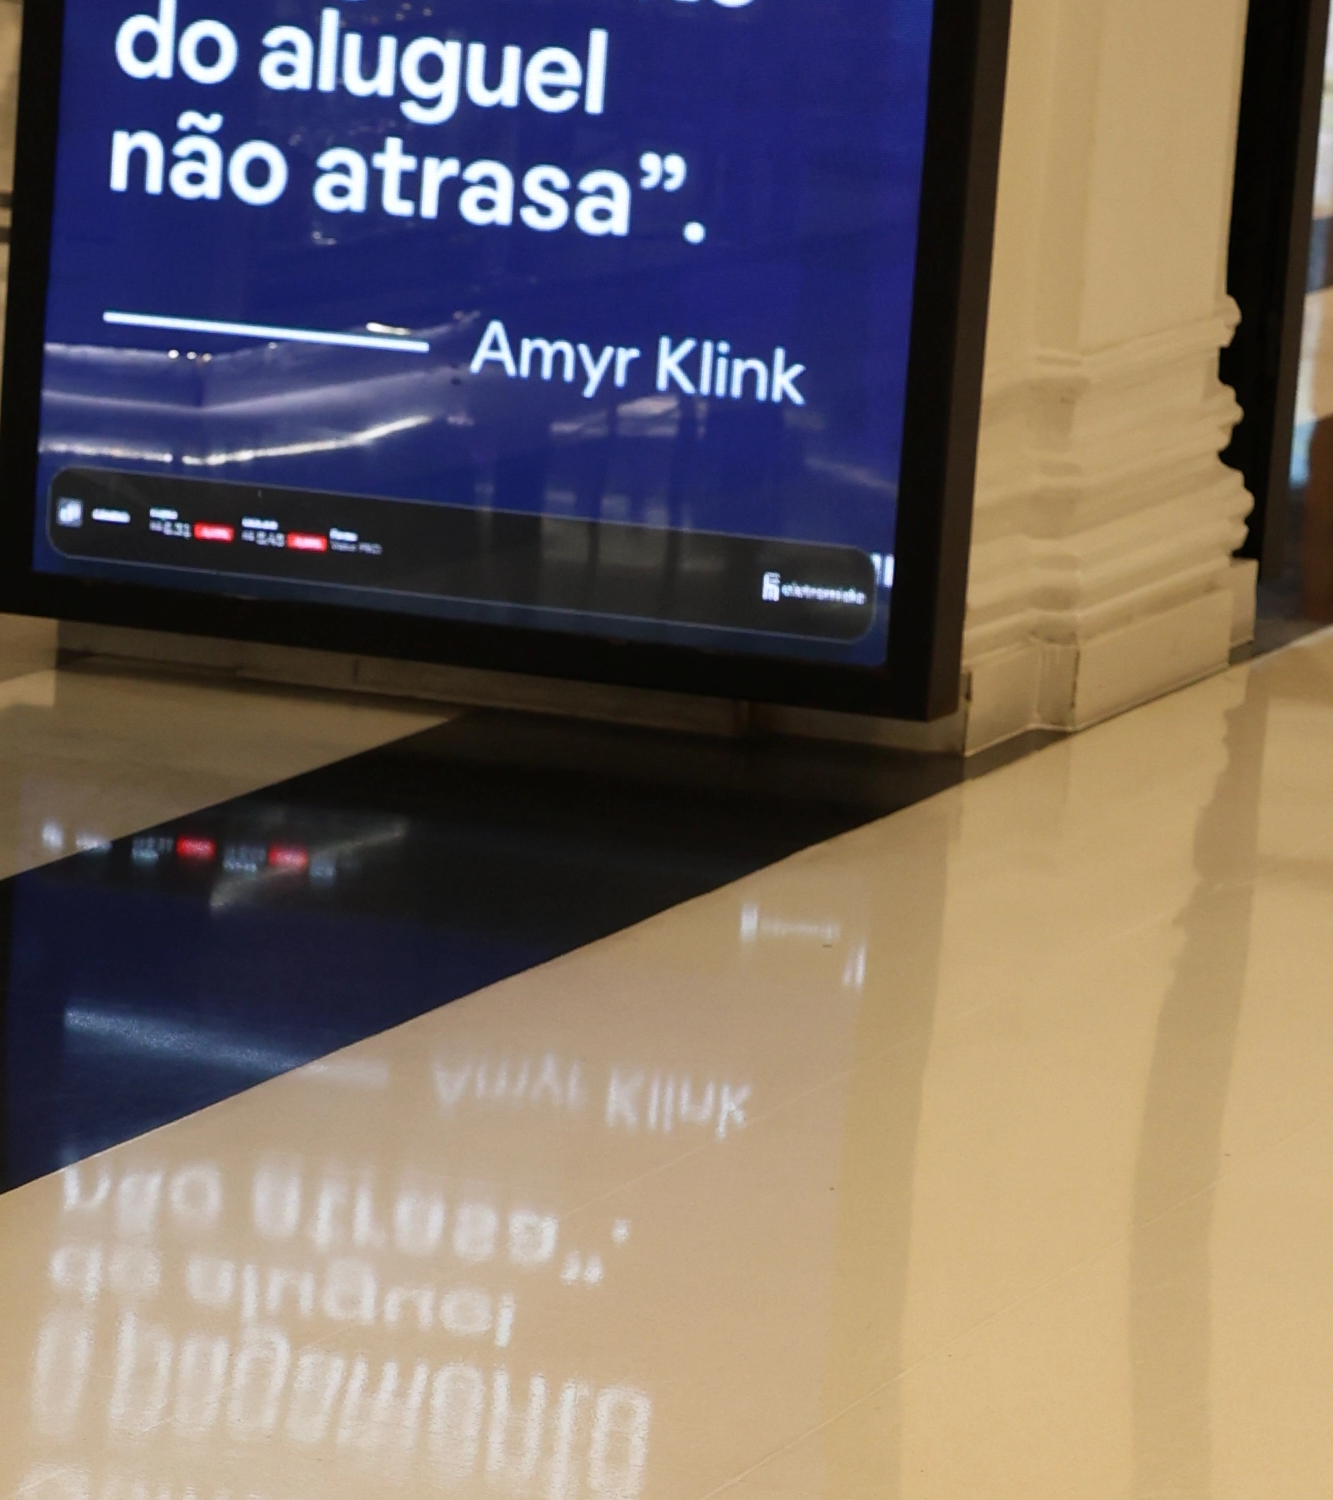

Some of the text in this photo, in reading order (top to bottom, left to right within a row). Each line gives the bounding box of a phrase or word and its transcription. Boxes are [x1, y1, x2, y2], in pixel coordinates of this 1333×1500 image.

[260, 8, 607, 124] aluguel
[110, 111, 704, 242] não atrasa”.
[469, 321, 805, 406] Amyr Klink
